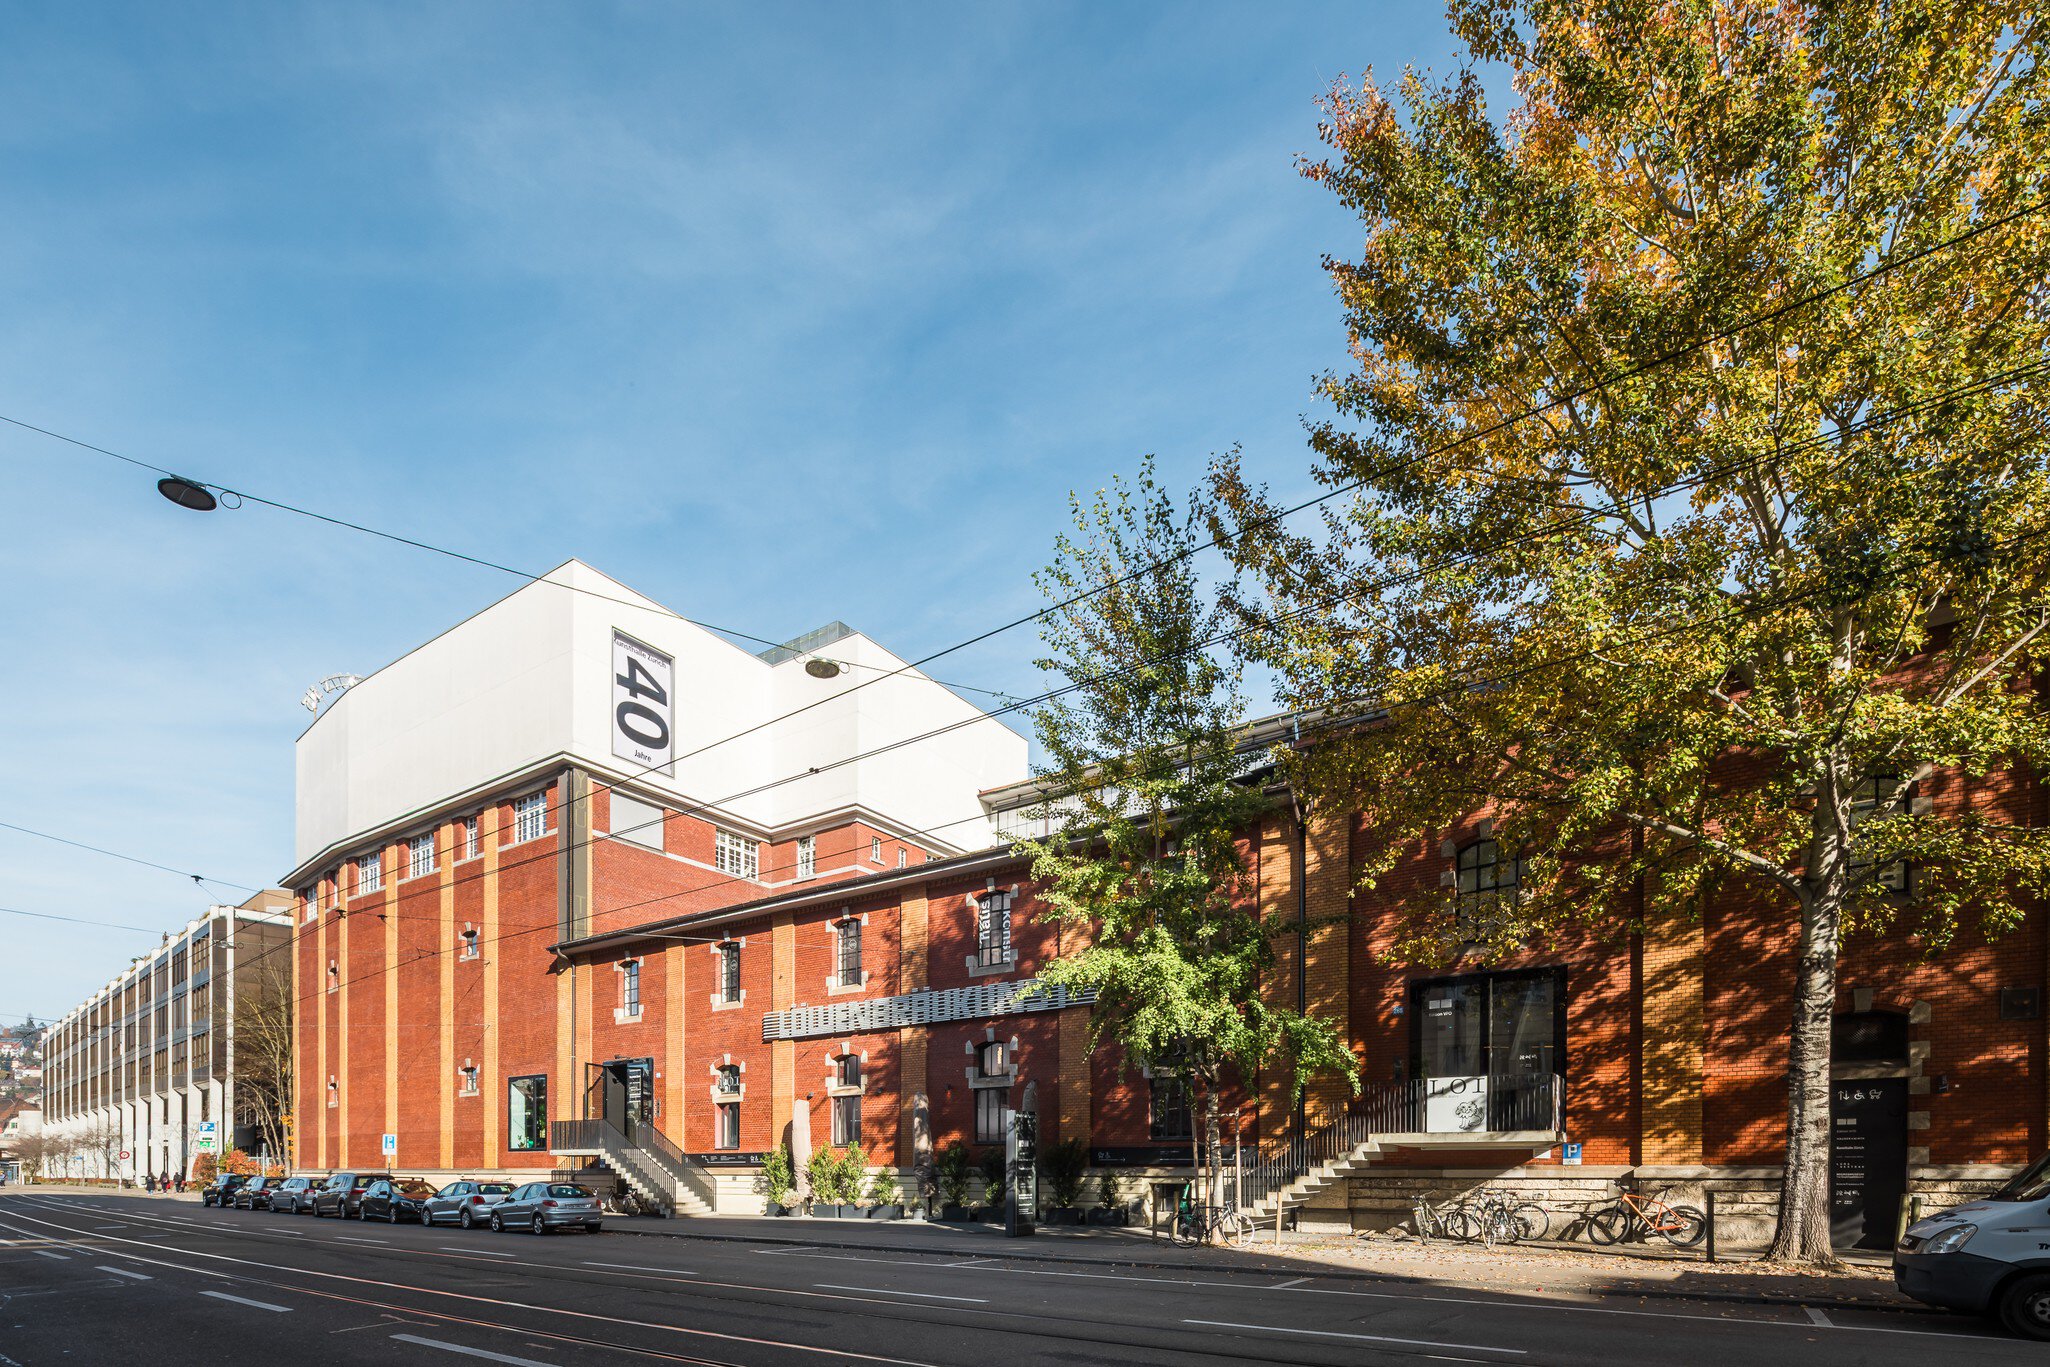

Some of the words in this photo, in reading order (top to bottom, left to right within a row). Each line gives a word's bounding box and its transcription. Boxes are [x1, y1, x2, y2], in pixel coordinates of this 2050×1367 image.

[616, 655, 670, 750] 40
[634, 749, 652, 763] Jahre
[1567, 1144, 1578, 1158] P
